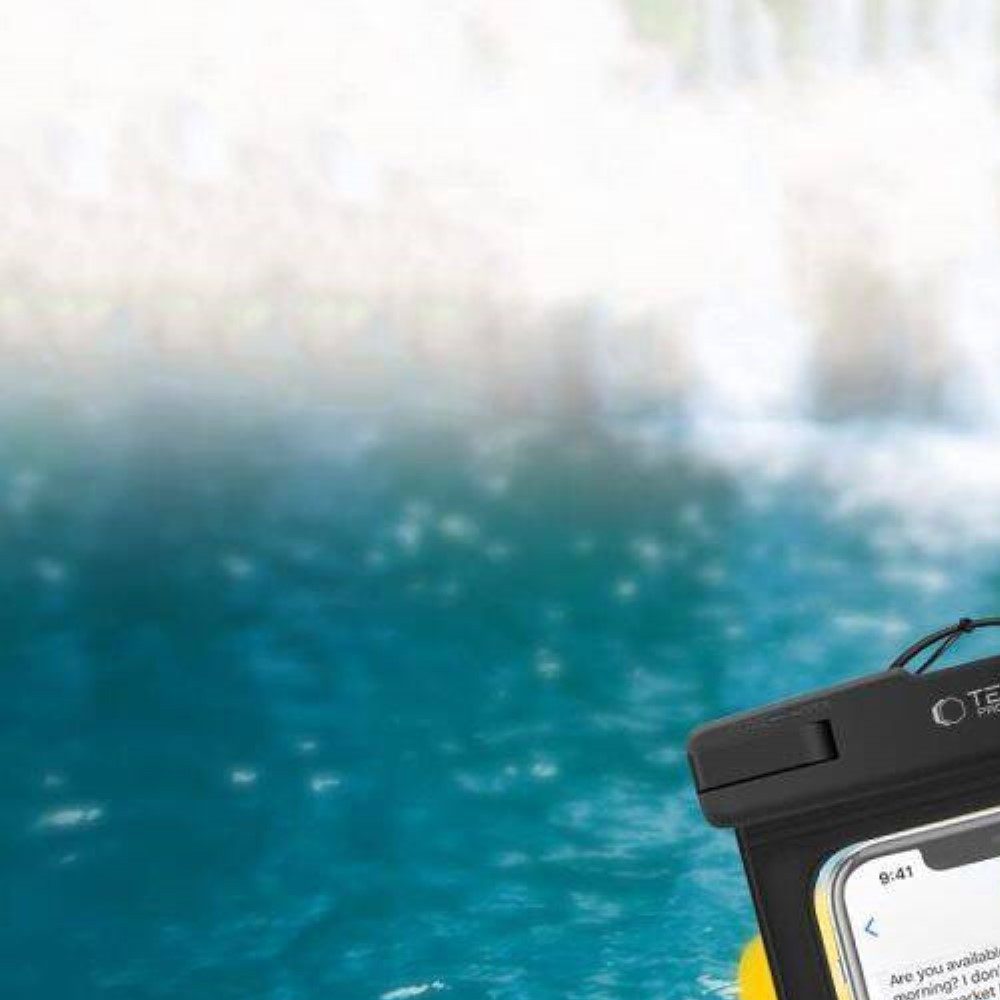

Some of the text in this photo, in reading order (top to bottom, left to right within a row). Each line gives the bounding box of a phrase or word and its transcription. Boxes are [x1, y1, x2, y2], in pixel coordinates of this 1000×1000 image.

[879, 865, 913, 884] 9:41
[890, 972, 913, 987] Are
[917, 964, 943, 982] you
